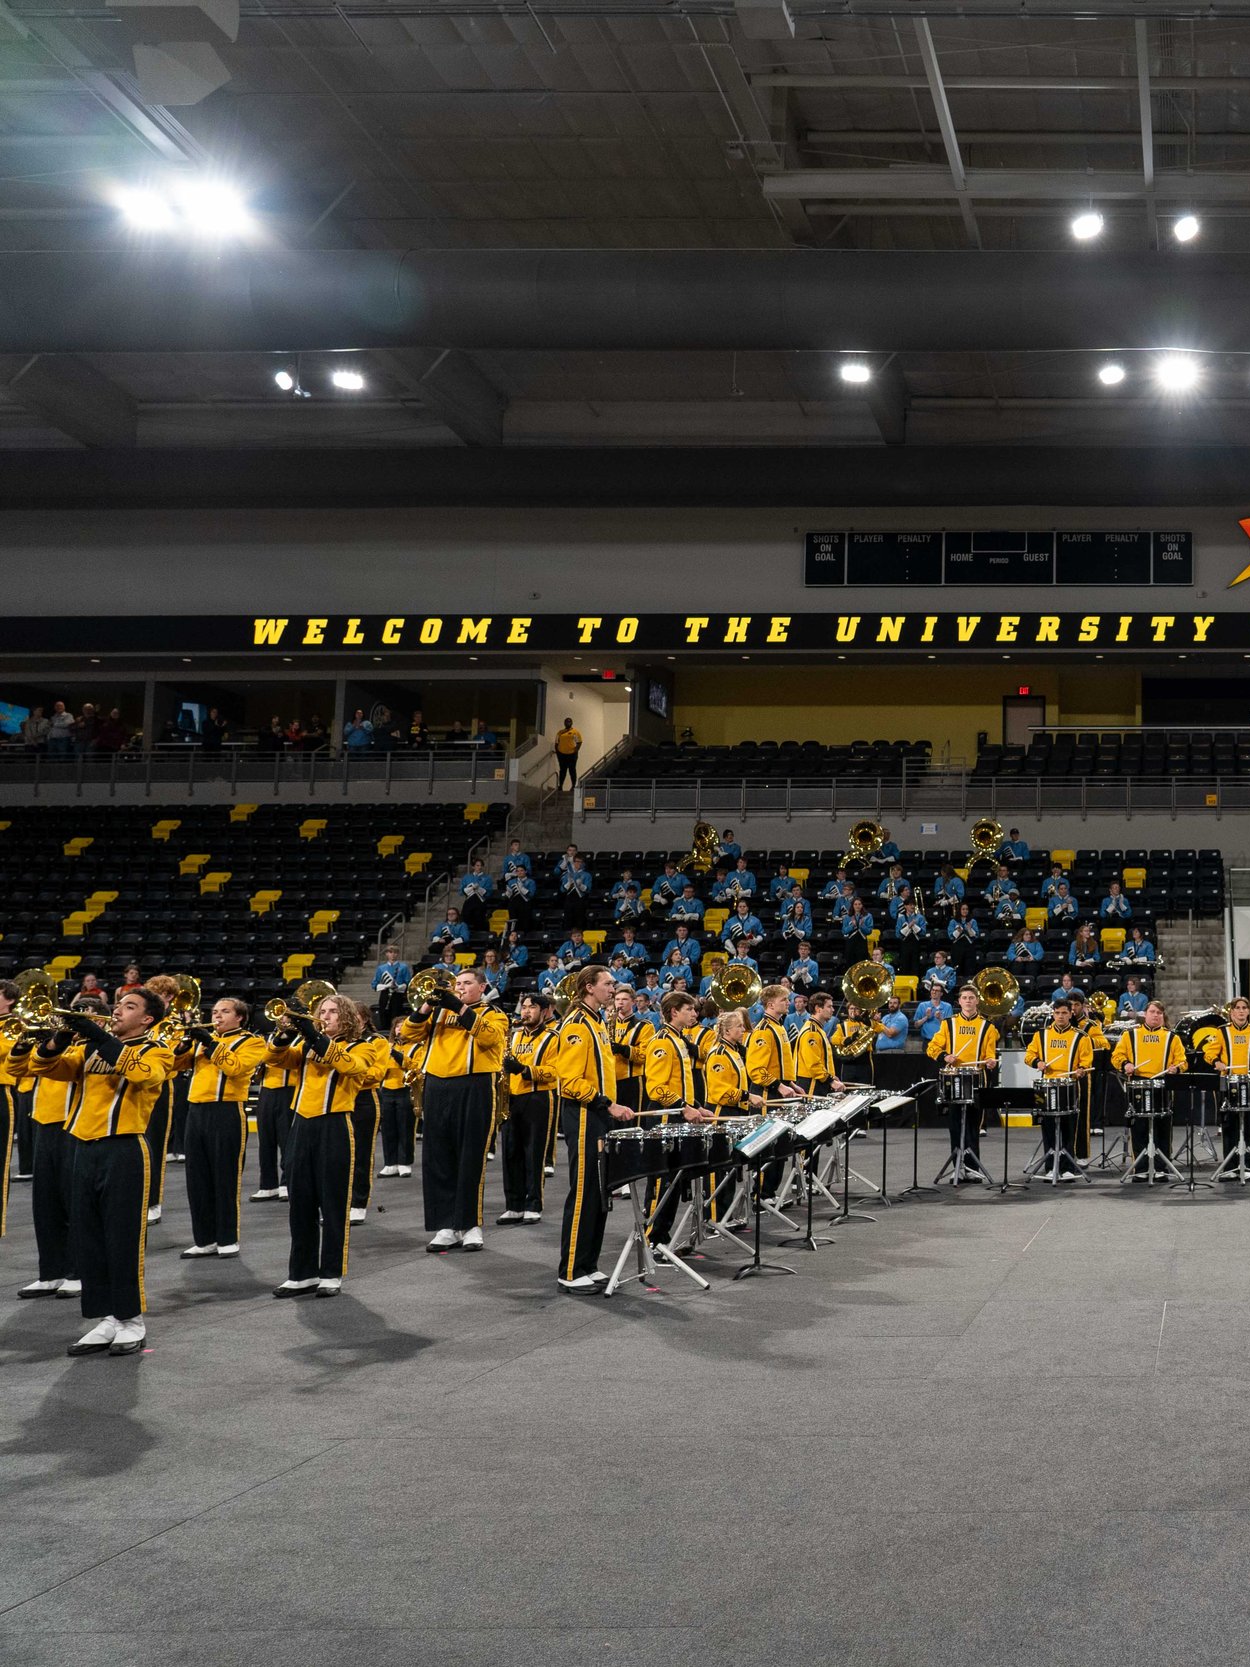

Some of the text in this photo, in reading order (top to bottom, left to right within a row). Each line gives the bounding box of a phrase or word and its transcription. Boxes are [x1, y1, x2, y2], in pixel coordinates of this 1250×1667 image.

[812, 534, 839, 543] SHOTS
[854, 534, 931, 543] PLAYER PENALTY
[1062, 533, 1139, 543] PLAYER PENALTY
[1160, 533, 1186, 543] SHOTS
[820, 543, 832, 552] ON
[1167, 542, 1179, 552] ON
[815, 552, 836, 562] GOAL
[950, 552, 974, 562] HOME
[1023, 552, 1049, 562] GUEST
[1162, 551, 1183, 561] GOAL
[253, 617, 531, 644] WELCOME
[577, 617, 639, 642] TO
[684, 617, 791, 642] THE
[835, 616, 1214, 641] UNIVERSITY
[959, 1026, 976, 1035] IOWA
[1050, 1039, 1067, 1049] IOWA
[1143, 1035, 1160, 1043] IOWA
